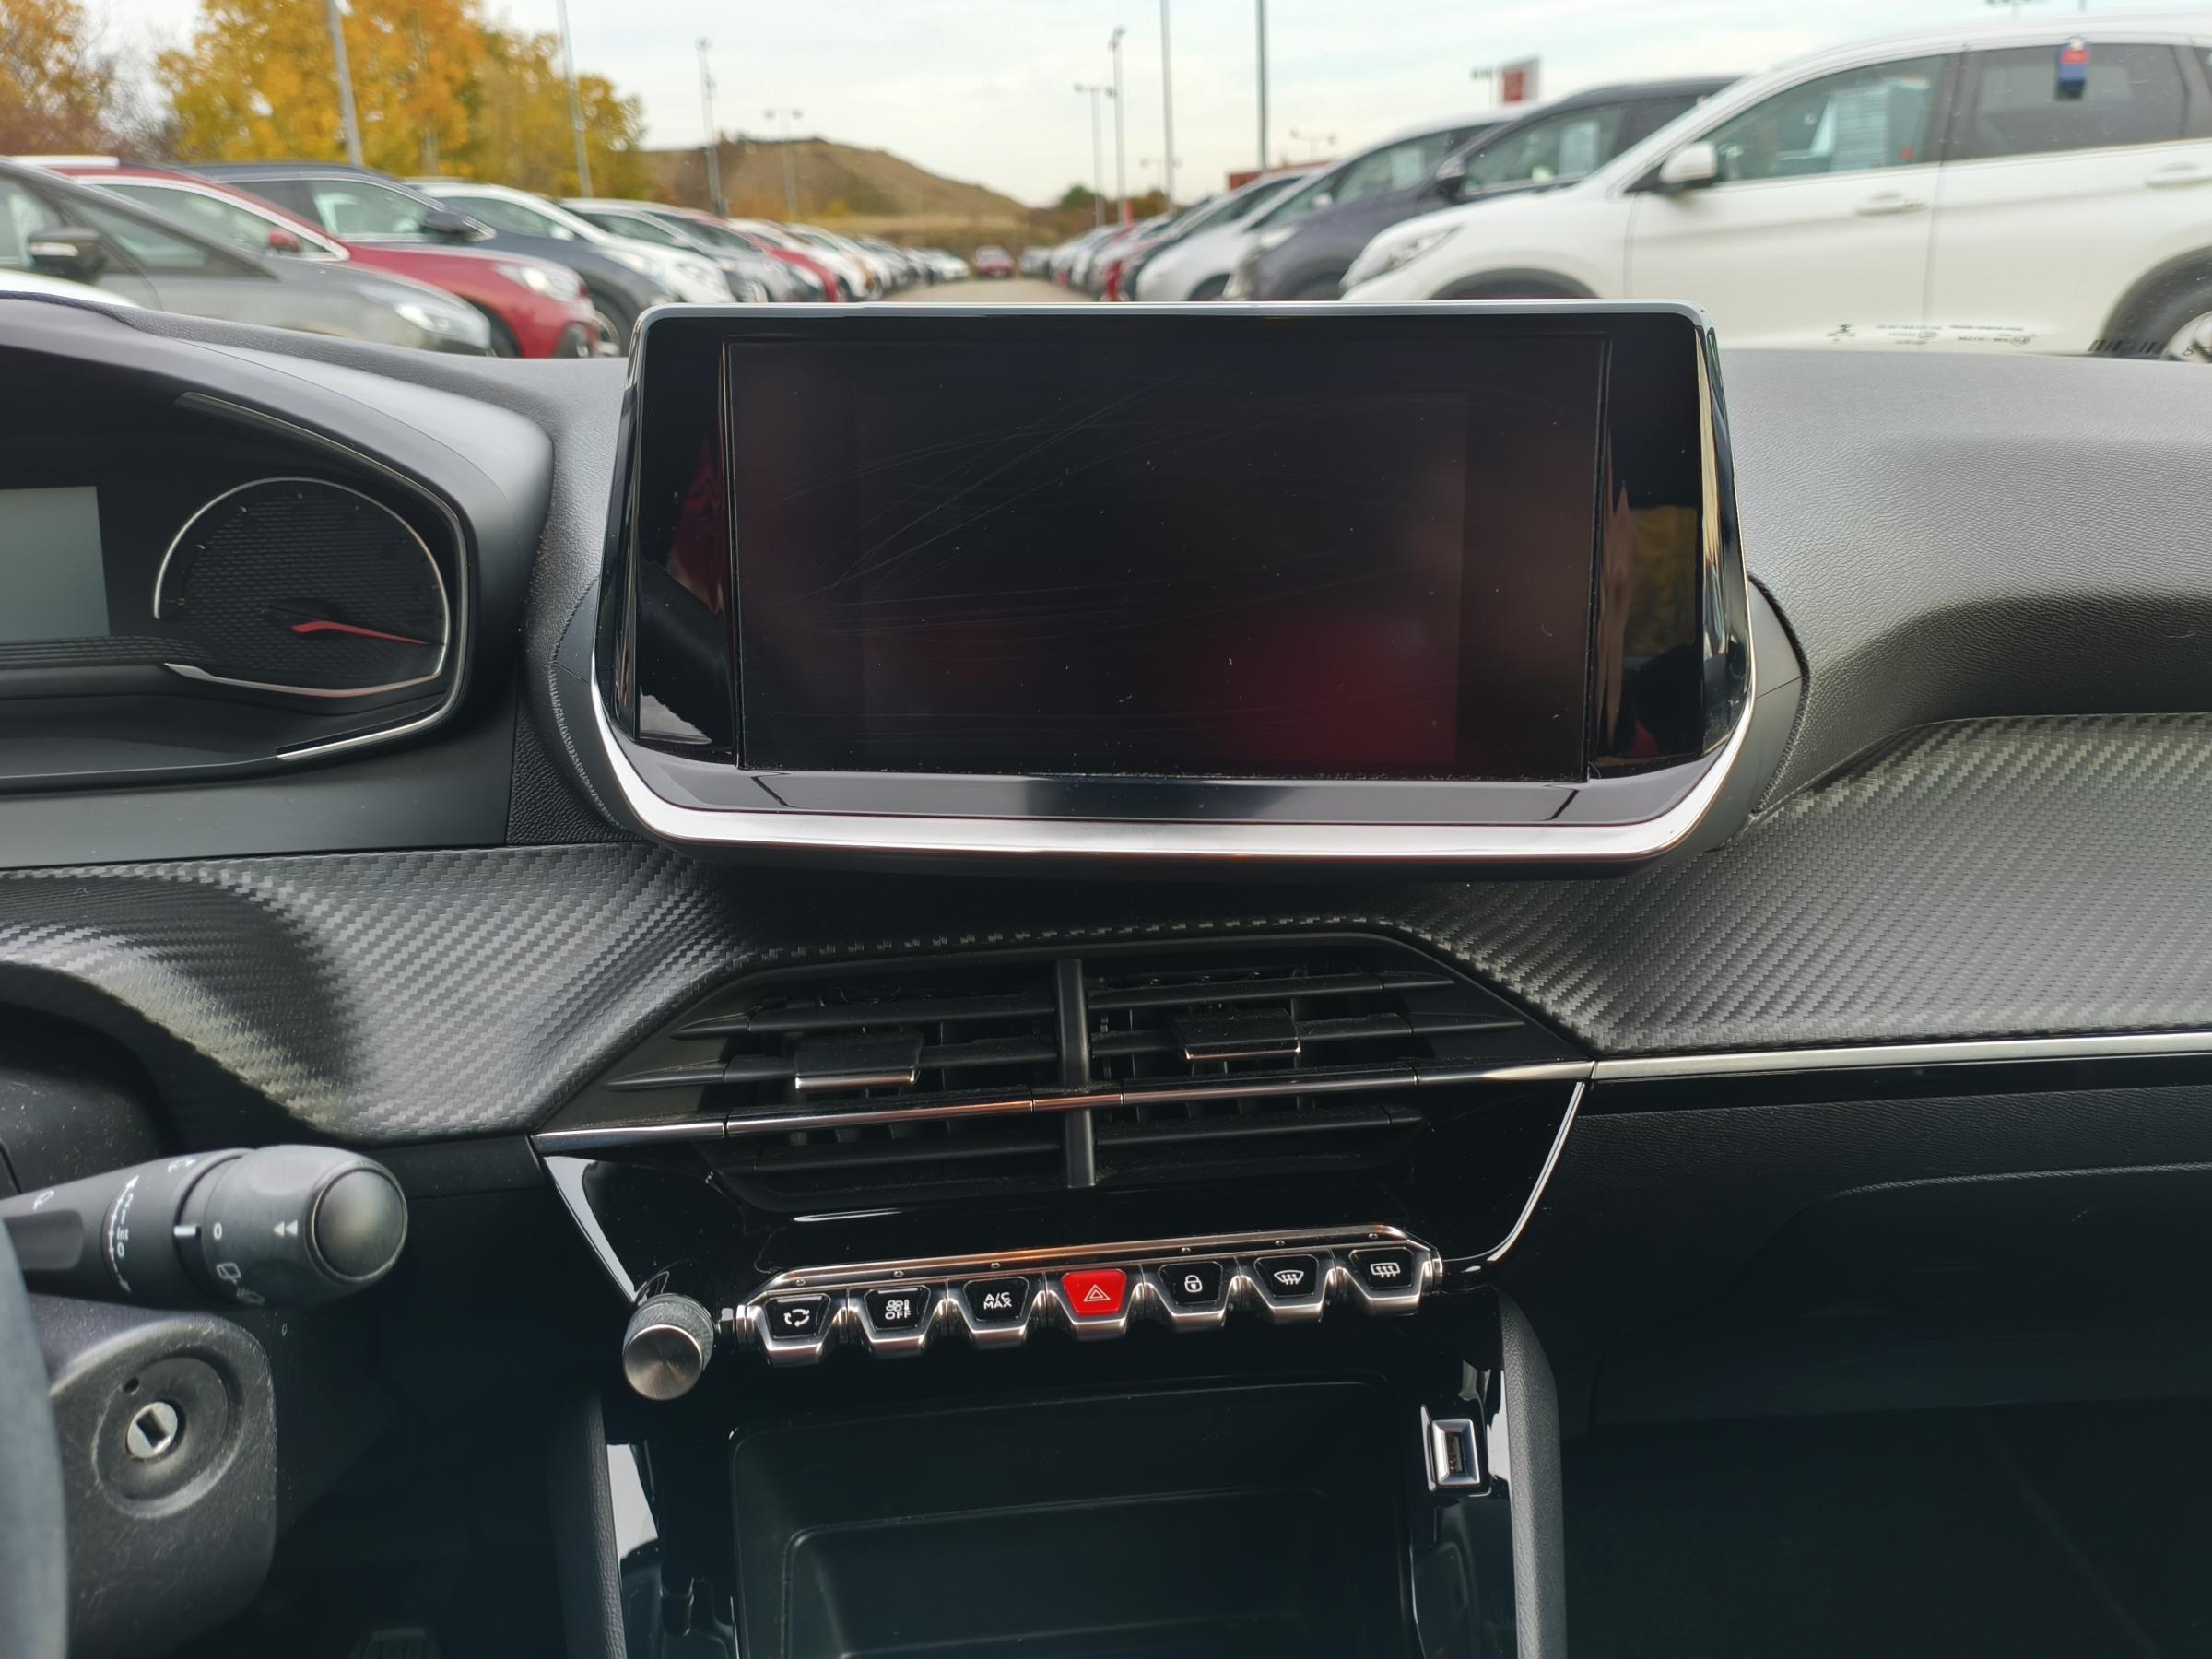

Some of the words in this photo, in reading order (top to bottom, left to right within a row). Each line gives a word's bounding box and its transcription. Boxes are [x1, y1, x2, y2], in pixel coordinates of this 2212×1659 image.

[985, 1291, 1010, 1301] A/C
[983, 1300, 1012, 1310] MAX
[885, 1311, 912, 1320] OFF
